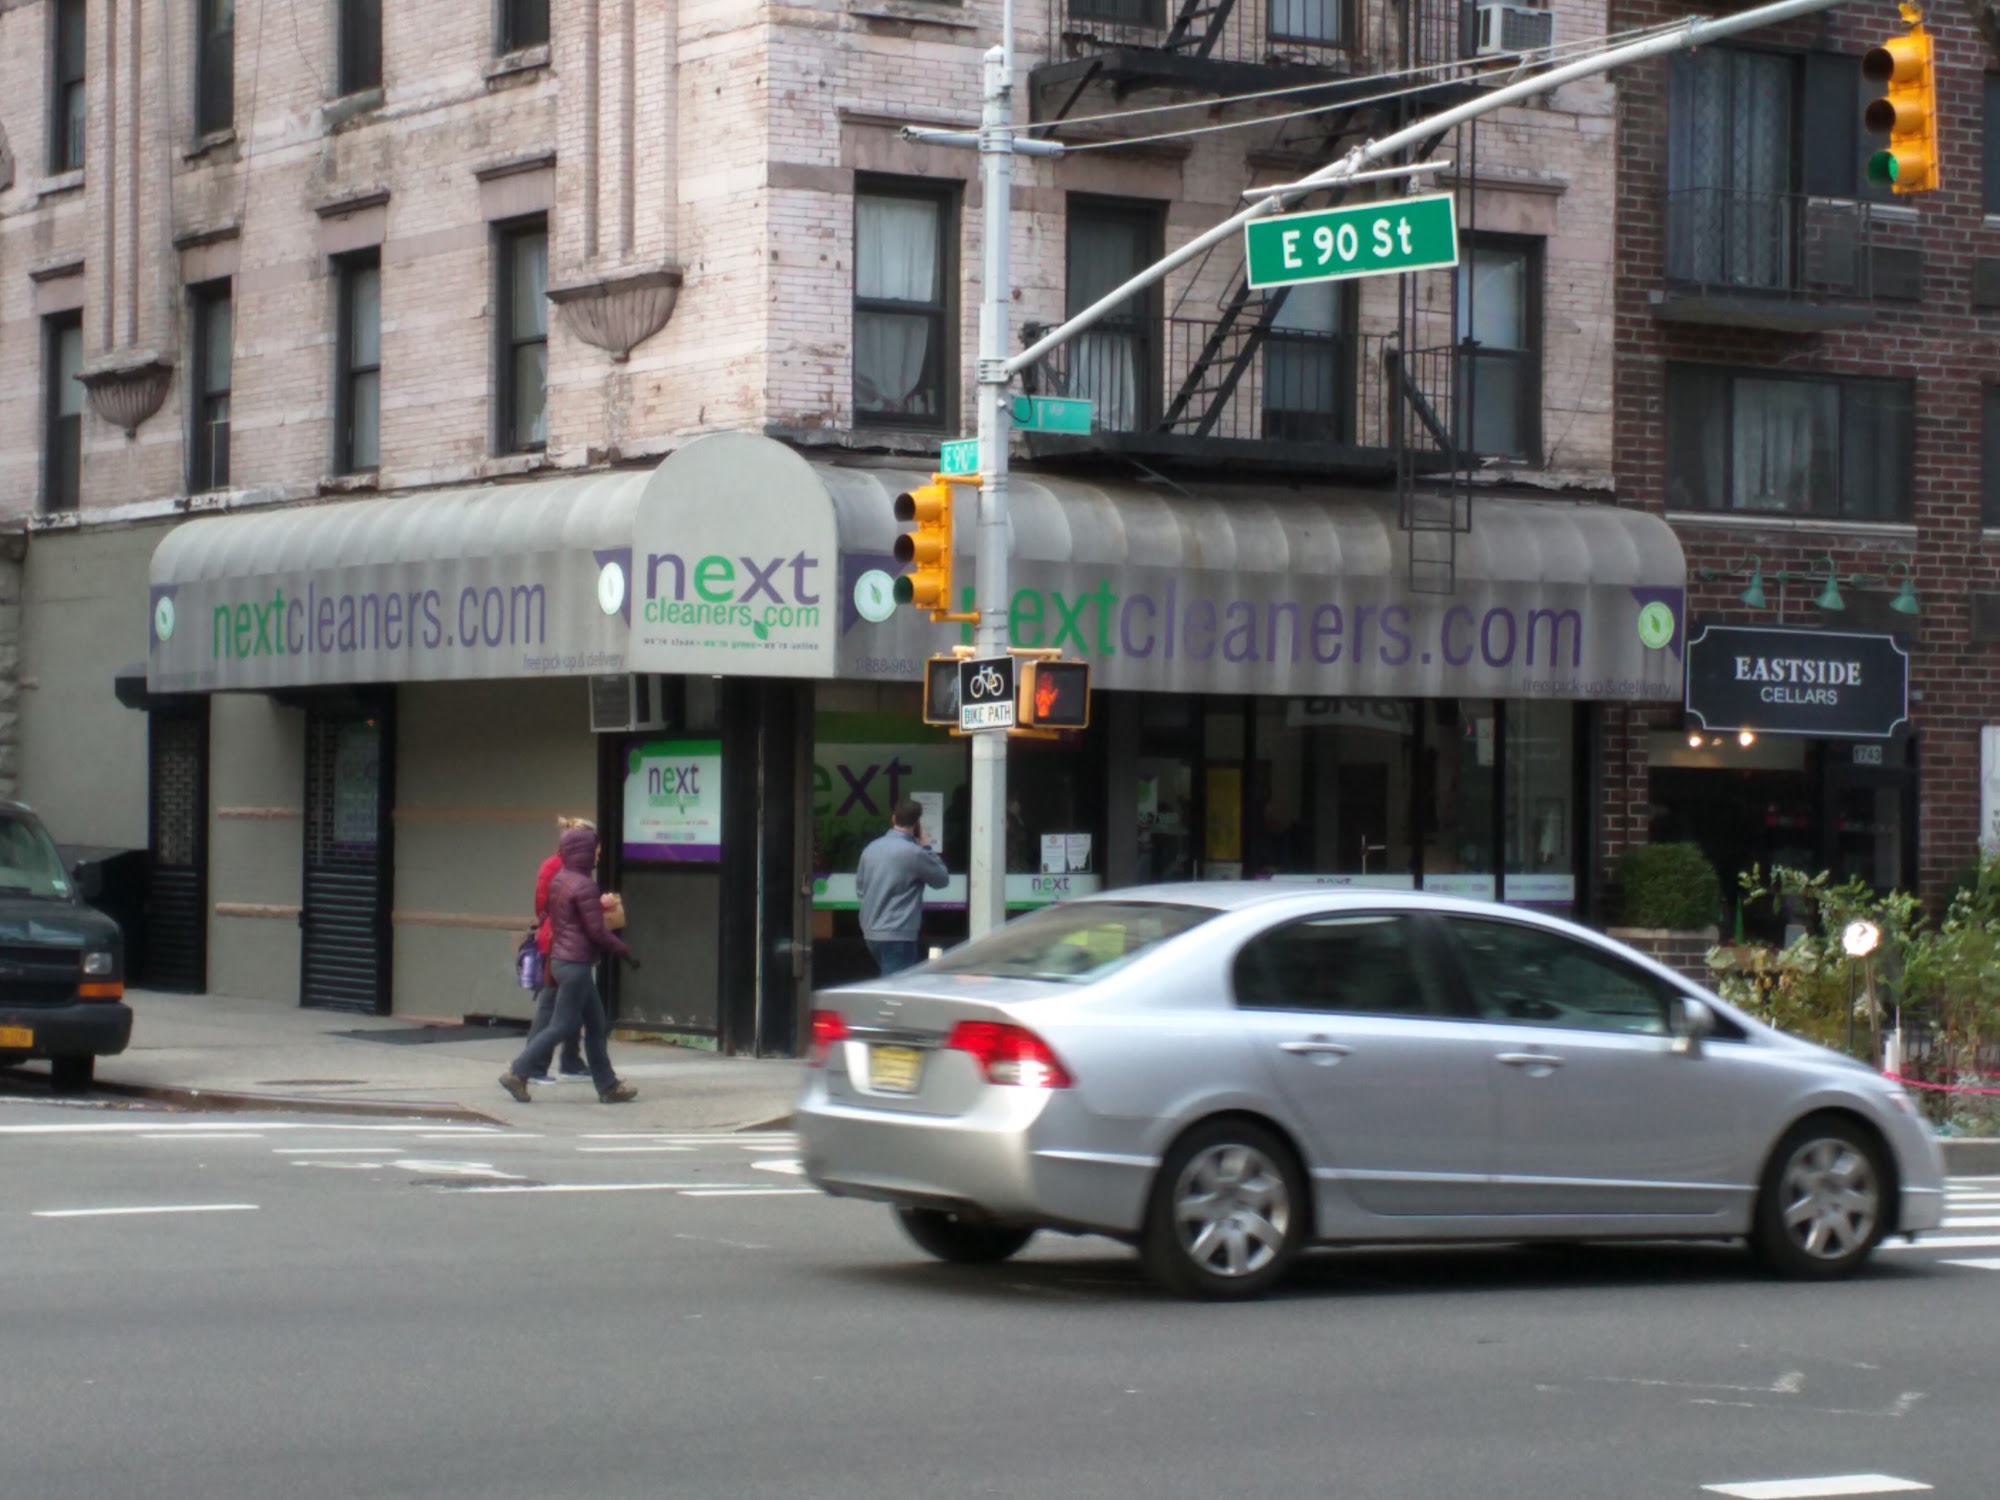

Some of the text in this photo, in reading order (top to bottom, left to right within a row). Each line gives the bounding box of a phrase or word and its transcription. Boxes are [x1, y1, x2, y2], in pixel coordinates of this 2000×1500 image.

[1282, 216, 1413, 269] E 90 St
[944, 446, 951, 472] E
[646, 550, 820, 605] next
[212, 580, 546, 660] nextcleaners.com
[1735, 656, 1862, 686] EASTSIDE
[1760, 686, 1838, 705] CELLARS
[964, 704, 1011, 725] BIKE PATH
[648, 763, 700, 795] next
[1031, 877, 1070, 891] next
